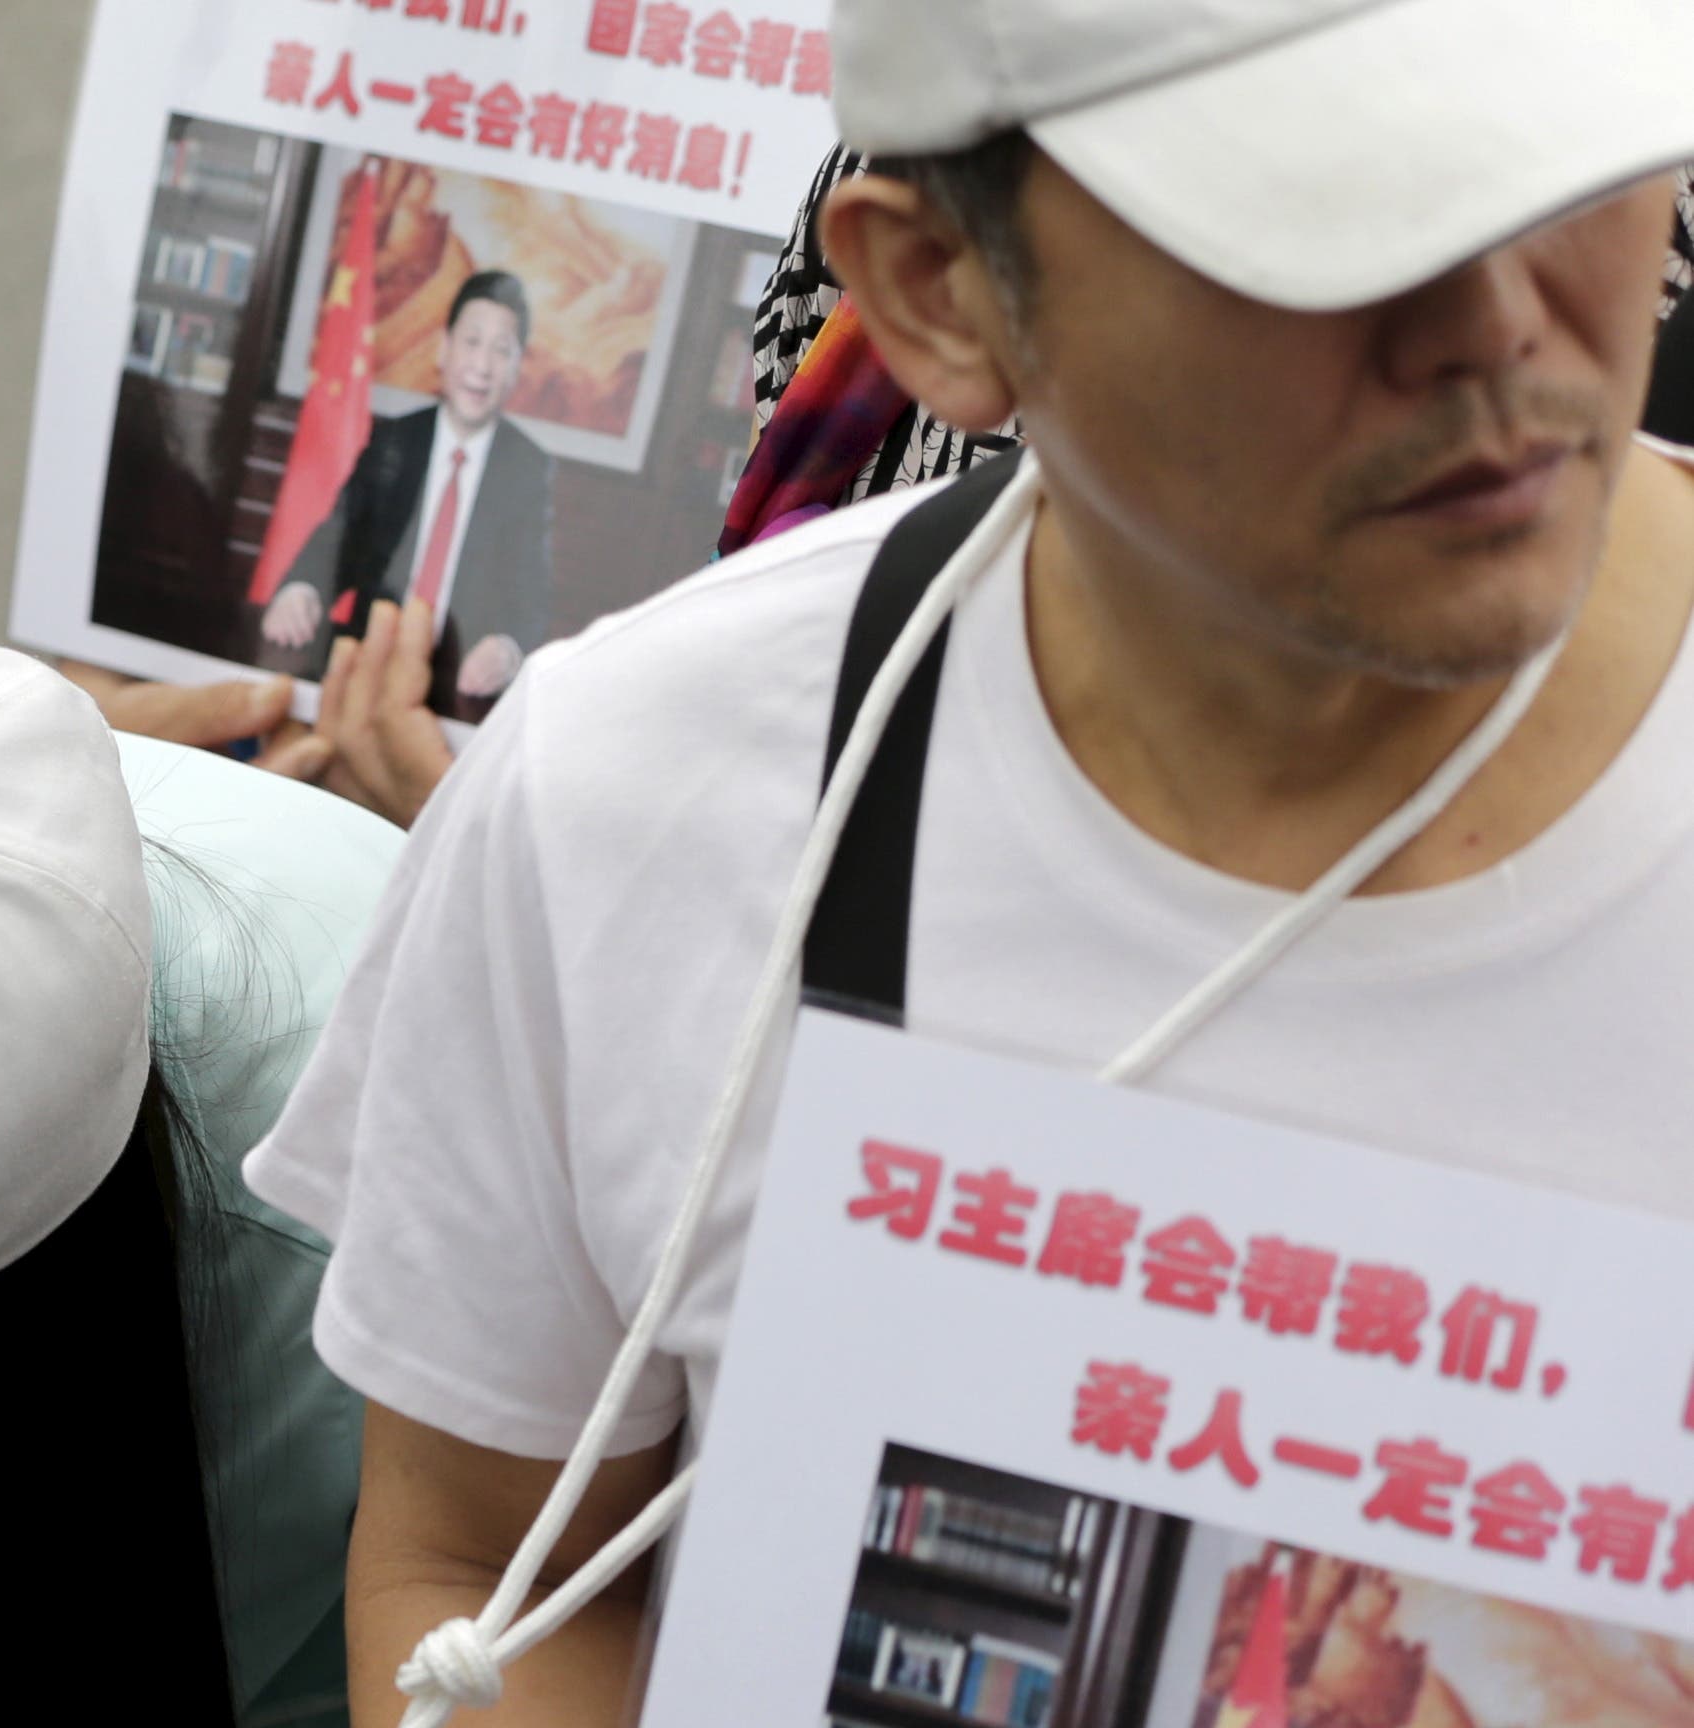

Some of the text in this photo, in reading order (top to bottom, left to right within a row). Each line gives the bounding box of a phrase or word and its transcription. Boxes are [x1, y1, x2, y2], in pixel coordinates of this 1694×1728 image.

[266, 42, 752, 198] 亲人一定会有好消息！
[845, 1138, 1569, 1398] 习主席会帮我们，
